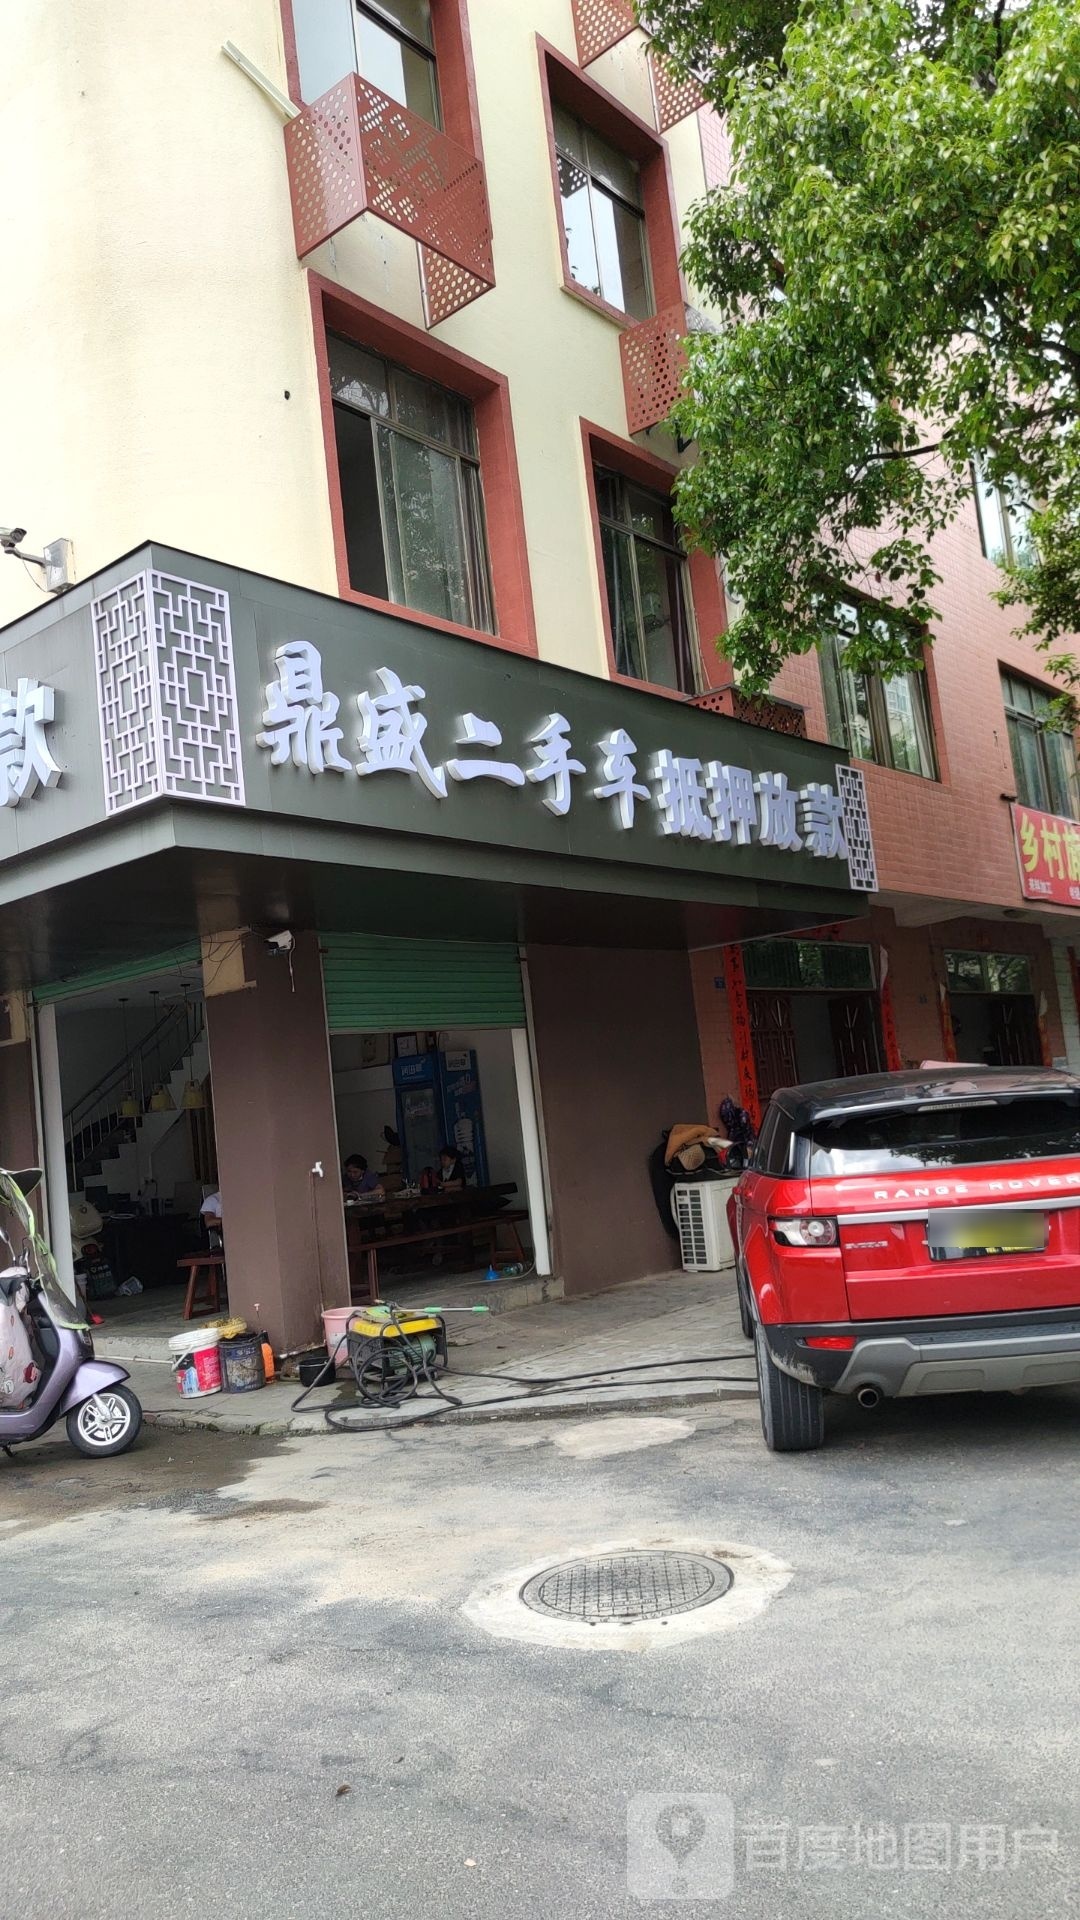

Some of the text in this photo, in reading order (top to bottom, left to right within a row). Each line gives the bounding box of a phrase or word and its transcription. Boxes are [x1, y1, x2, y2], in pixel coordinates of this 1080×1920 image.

[255, 640, 849, 861] 鼎盛二手车抵押放款
[873, 1174, 1080, 1200] RANGE ROVER
